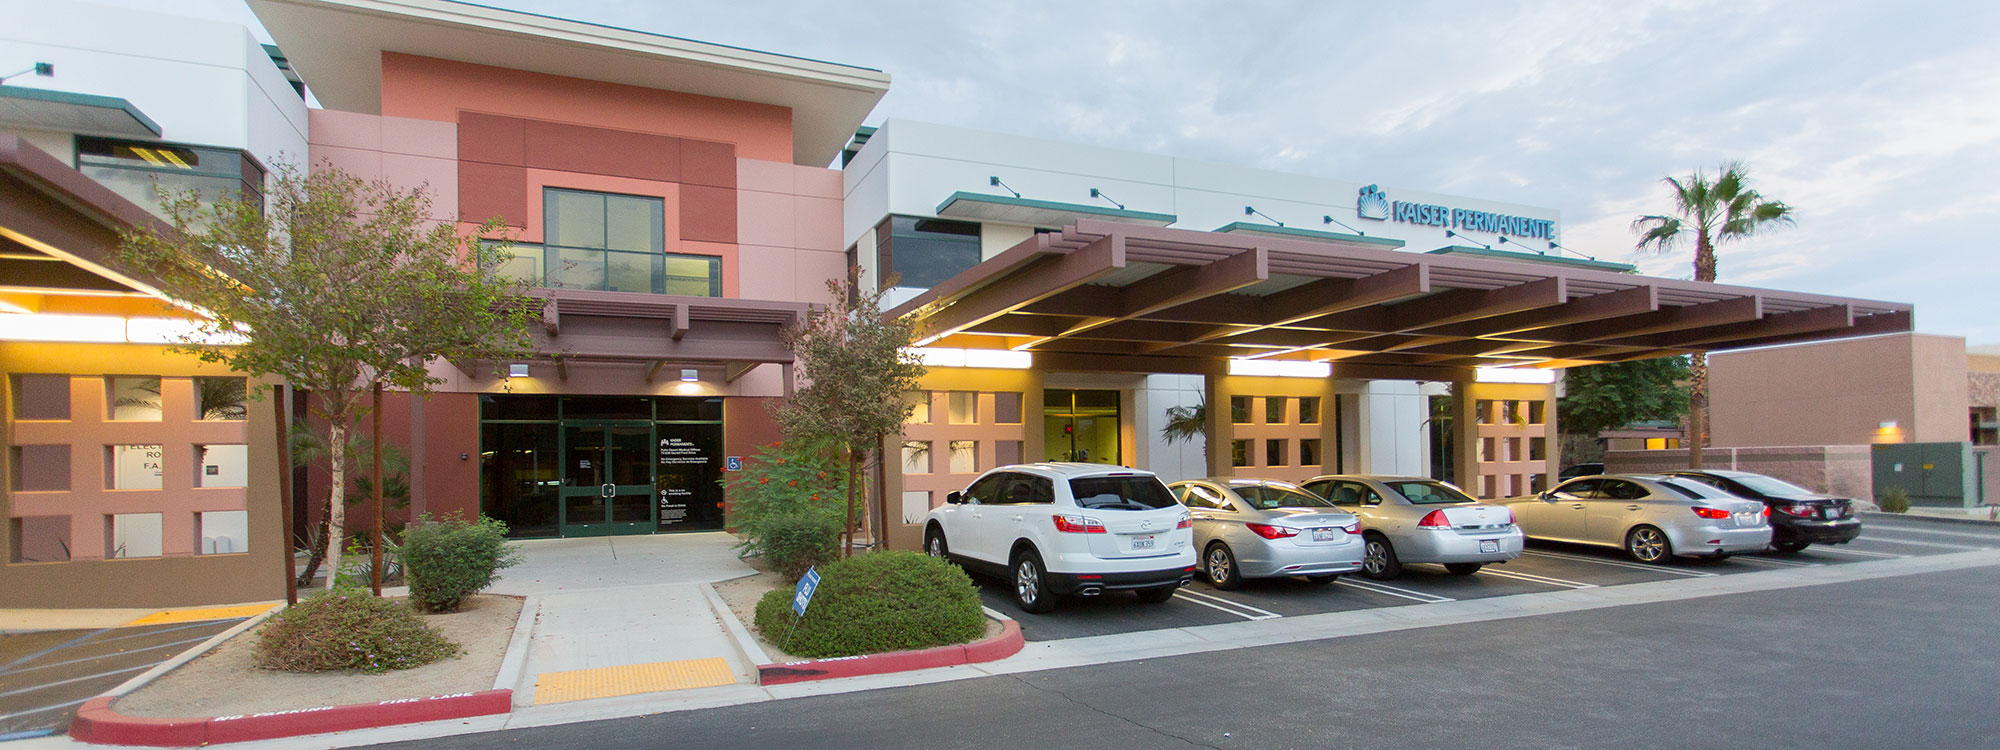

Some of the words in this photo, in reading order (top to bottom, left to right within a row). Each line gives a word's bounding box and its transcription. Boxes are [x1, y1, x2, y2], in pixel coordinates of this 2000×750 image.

[1392, 200, 1450, 227] KAISER
[1452, 207, 1556, 240] PERMANENTE
[213, 714, 244, 722] NO
[253, 705, 334, 718] PARKING
[379, 697, 421, 705] FIRE
[429, 691, 474, 700] LANE
